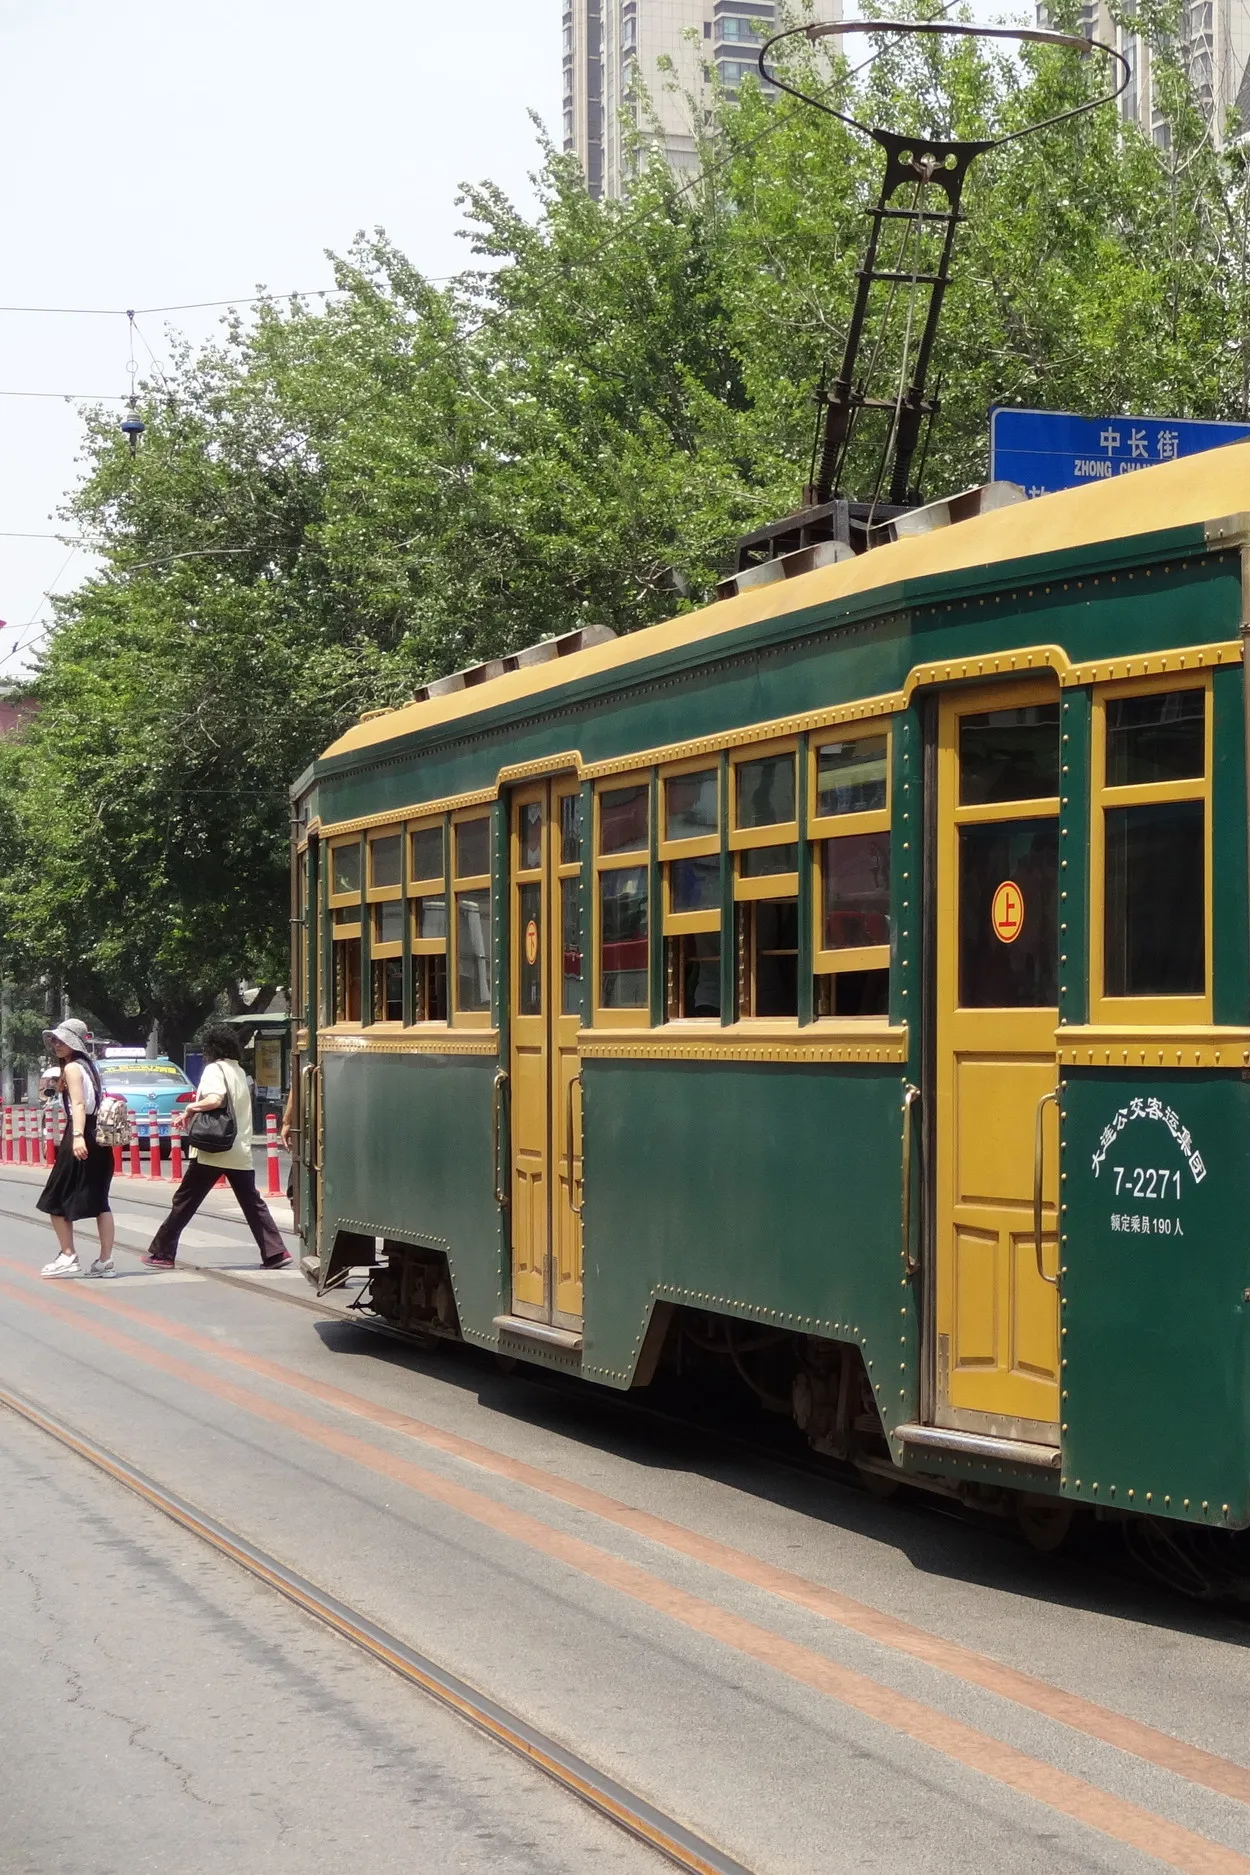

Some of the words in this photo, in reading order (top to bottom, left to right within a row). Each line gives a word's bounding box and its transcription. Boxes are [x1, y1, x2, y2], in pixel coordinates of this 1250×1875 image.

[1100, 427, 1179, 459] 中长街
[1074, 459, 1112, 477] ZHONG
[998, 892, 1017, 927] 上
[1091, 1097, 1207, 1184] 大连公交客运集团
[1113, 1167, 1181, 1200] 7-2271
